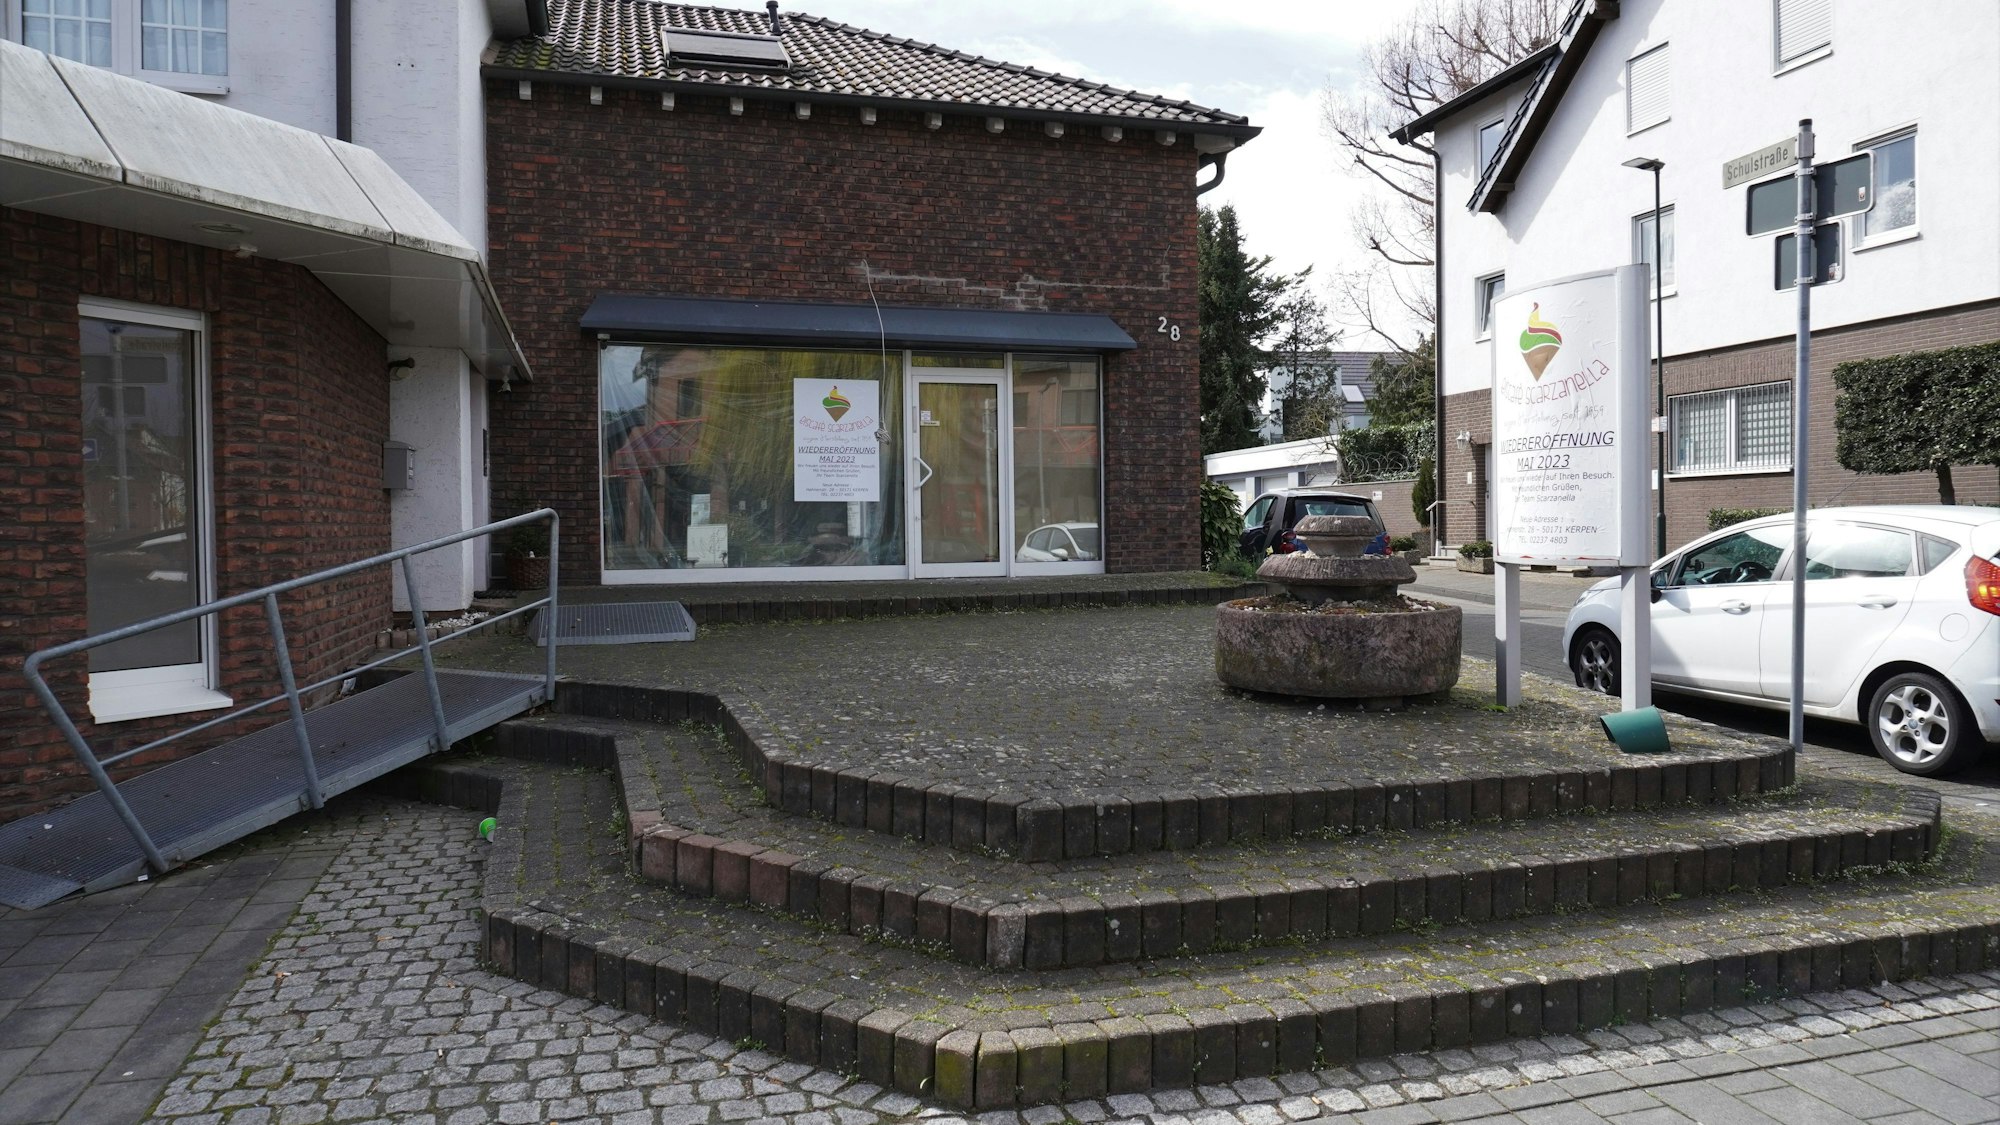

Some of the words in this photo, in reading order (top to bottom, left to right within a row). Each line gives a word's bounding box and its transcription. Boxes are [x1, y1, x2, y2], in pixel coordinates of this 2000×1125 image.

[1727, 146, 1789, 181] Schulstraße
[1157, 316, 1181, 342] 28
[1501, 431, 1615, 453] WIEDERERÖFFNUNG
[798, 445, 876, 455] WIEDERERÖFFNUNG
[1517, 456, 1535, 470] MAI
[1538, 455, 1571, 469] 2023
[1559, 472, 1580, 480] Ihren
[1582, 471, 1615, 480] Besuch.
[1565, 525, 1599, 534] KERPEN
[1549, 535, 1568, 544] 4803
